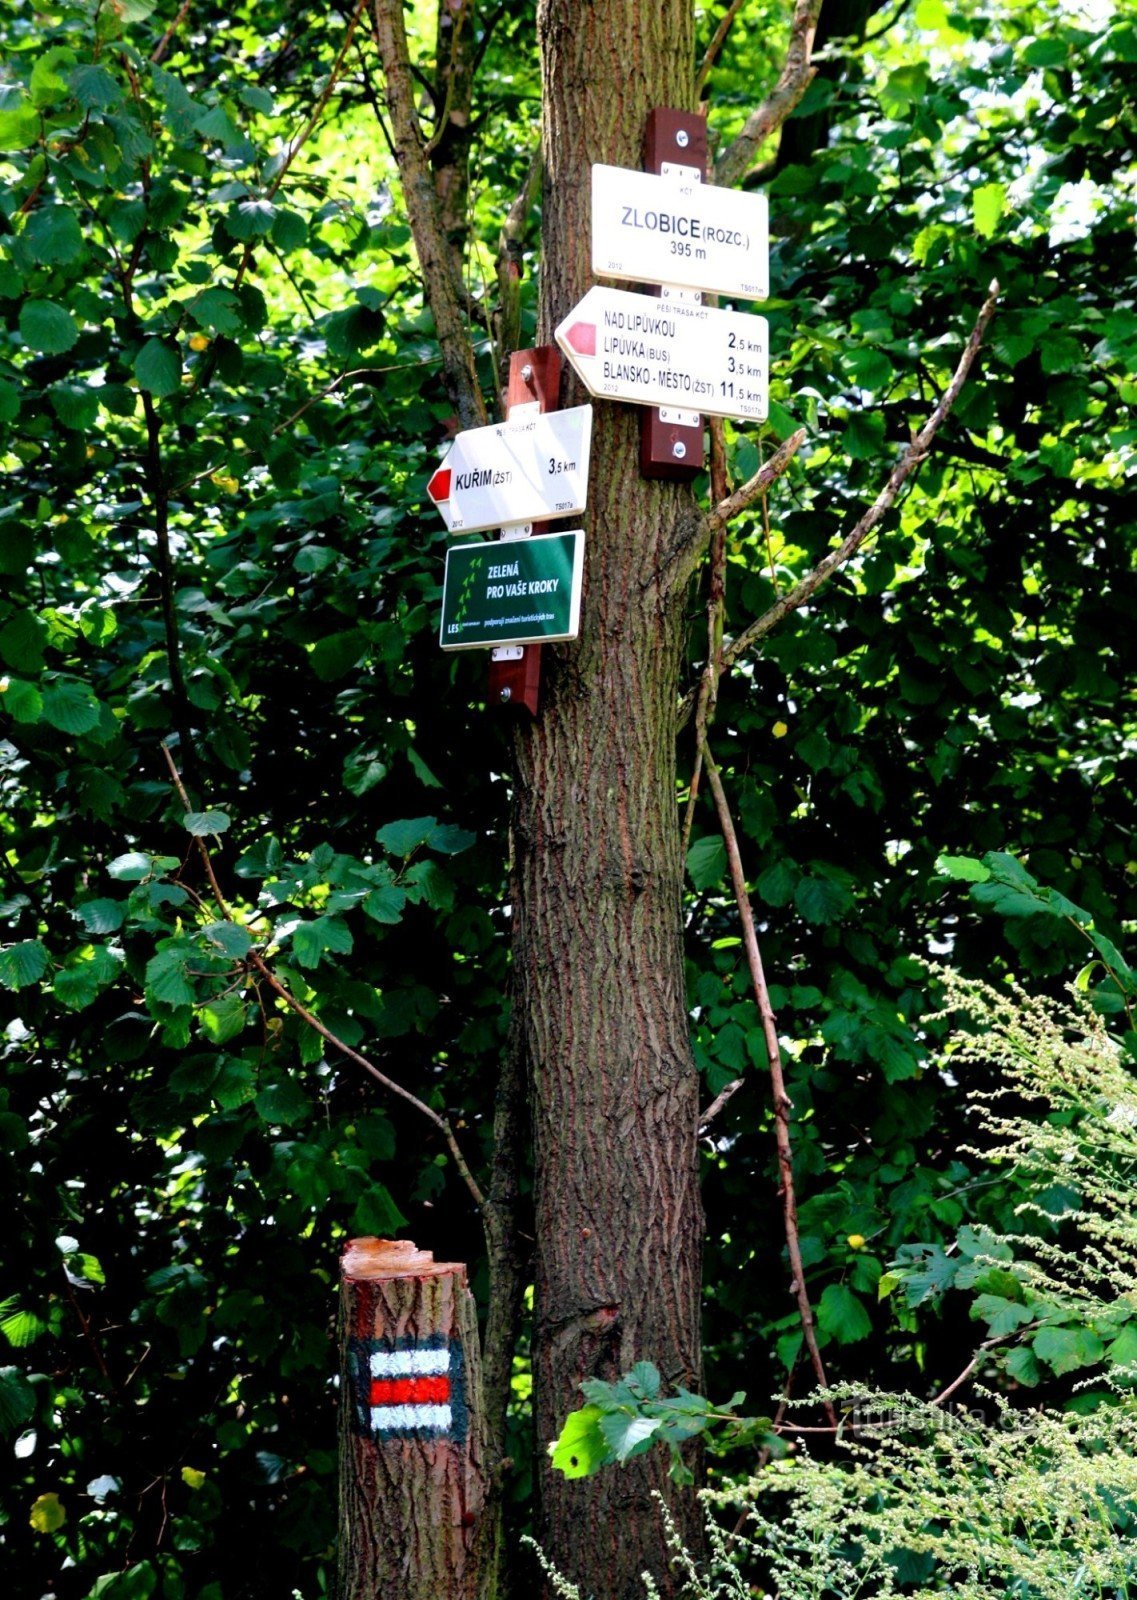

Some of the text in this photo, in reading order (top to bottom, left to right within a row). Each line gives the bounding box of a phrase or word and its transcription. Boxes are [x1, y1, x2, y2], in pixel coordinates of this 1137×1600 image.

[622, 206, 750, 250] ZLOBICE (ROZC.)
[671, 241, 706, 259] 395 m
[608, 262, 622, 270] 2012
[604, 310, 762, 353] NAD LIPŮVKOU 2,5 km
[604, 336, 762, 378] LIPŮVKA (BUS) 3,5 km
[604, 362, 650, 384] BLANSKO
[658, 369, 691, 391] MĚSTO
[720, 381, 745, 400] 11,5
[747, 388, 762, 402] km
[604, 384, 618, 393] 2012
[456, 458, 576, 491] KUŘIM (ŽST) 3,5 km
[452, 520, 463, 528] 2012
[488, 561, 520, 579] ZELENÁ
[486, 579, 559, 599] PRO VAŠE KROKY
